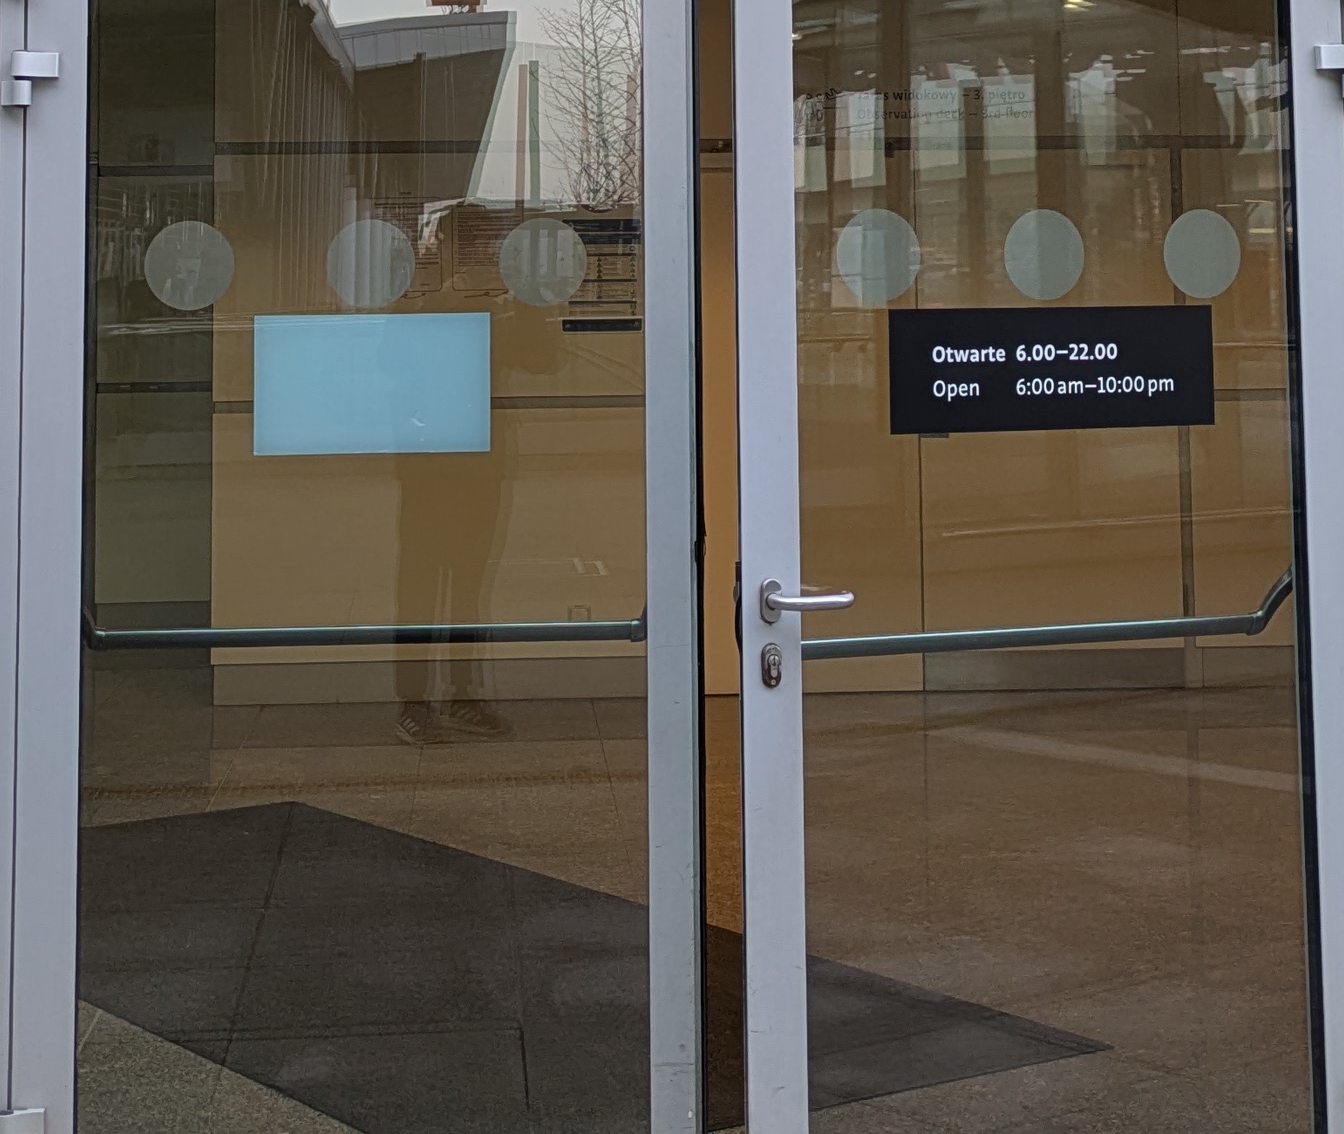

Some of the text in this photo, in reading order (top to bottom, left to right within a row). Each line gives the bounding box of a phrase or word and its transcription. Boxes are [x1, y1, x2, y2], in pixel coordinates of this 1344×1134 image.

[892, 88, 956, 103] widokowy
[932, 343, 1118, 363] Otwarte 6.00–22.00
[932, 379, 980, 402] Open
